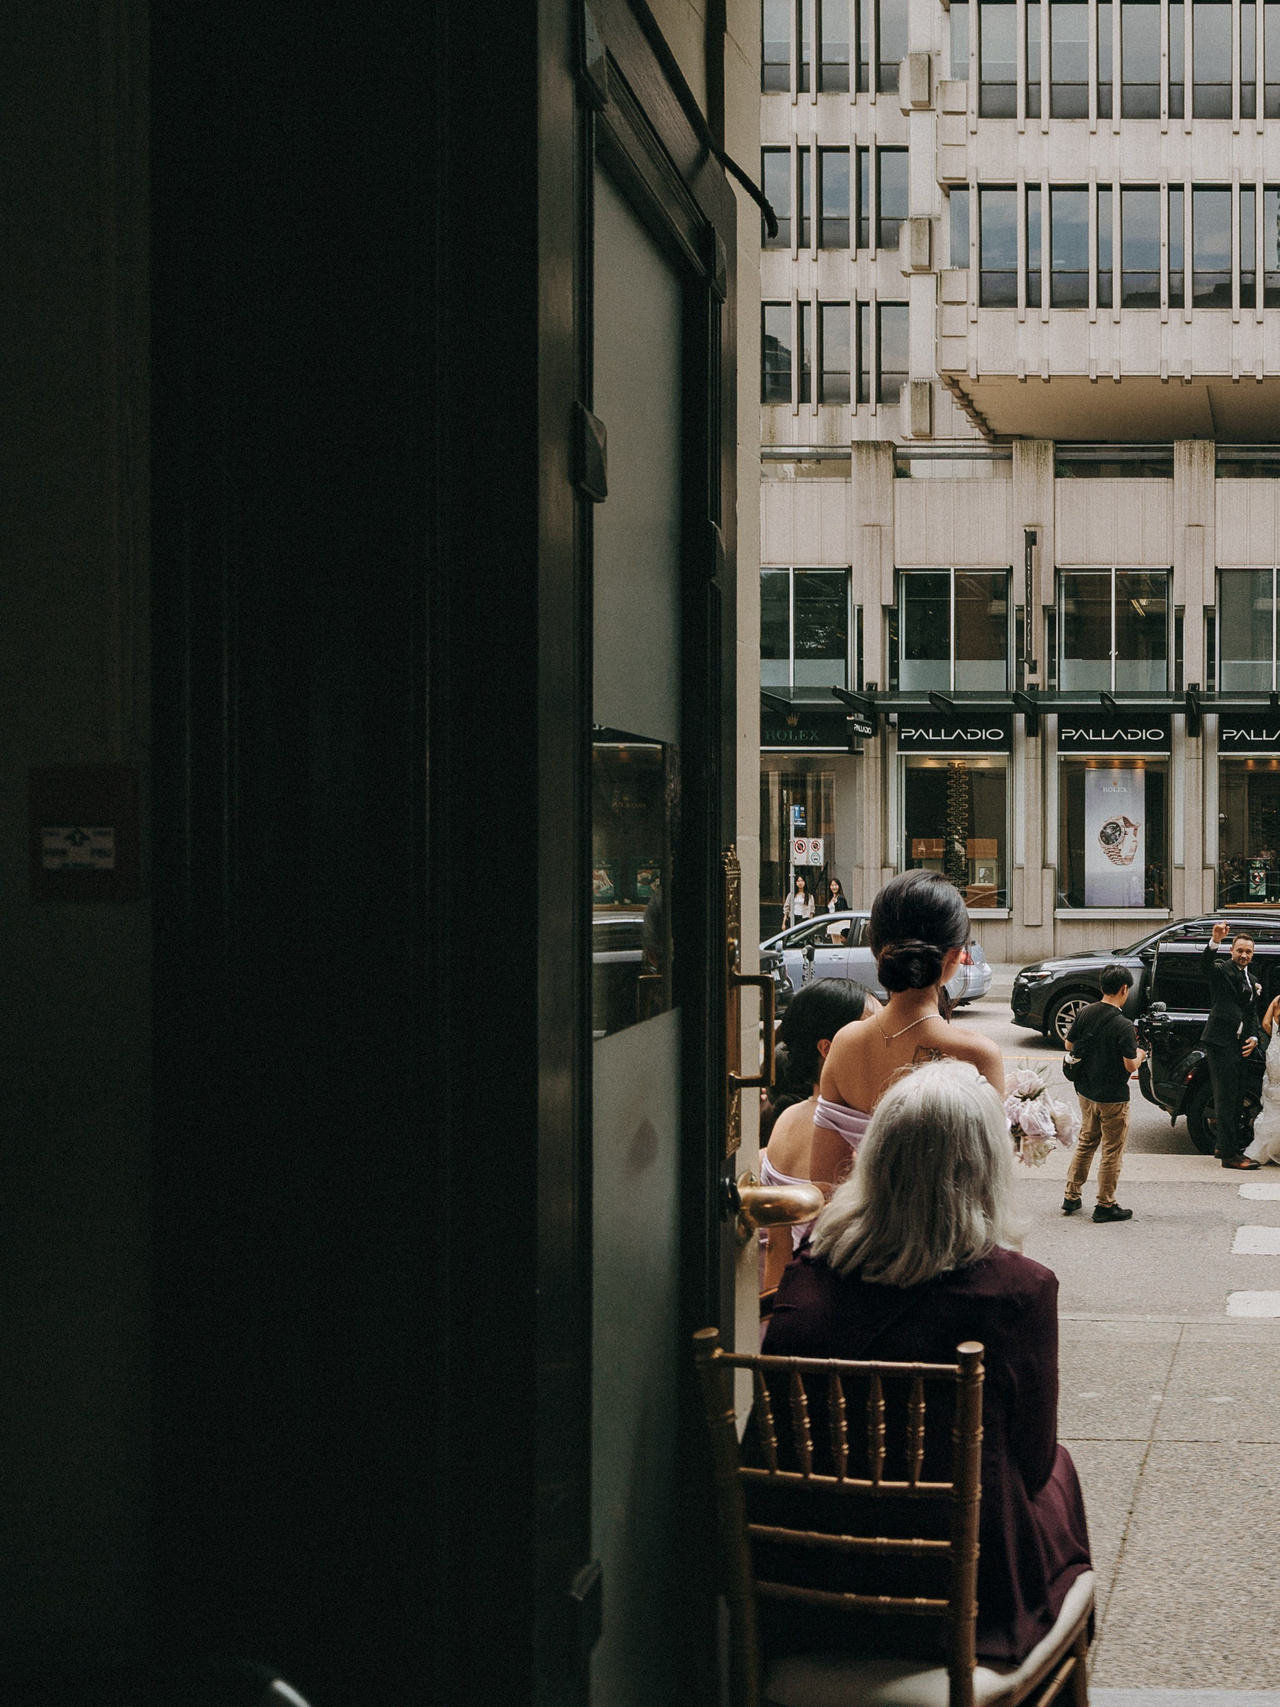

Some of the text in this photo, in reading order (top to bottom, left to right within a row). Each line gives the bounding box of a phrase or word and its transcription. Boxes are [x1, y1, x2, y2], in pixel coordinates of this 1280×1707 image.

[765, 729, 820, 741] ROLEX
[901, 728, 1004, 740] PALLADIO
[1061, 728, 1165, 741] PALLADIO
